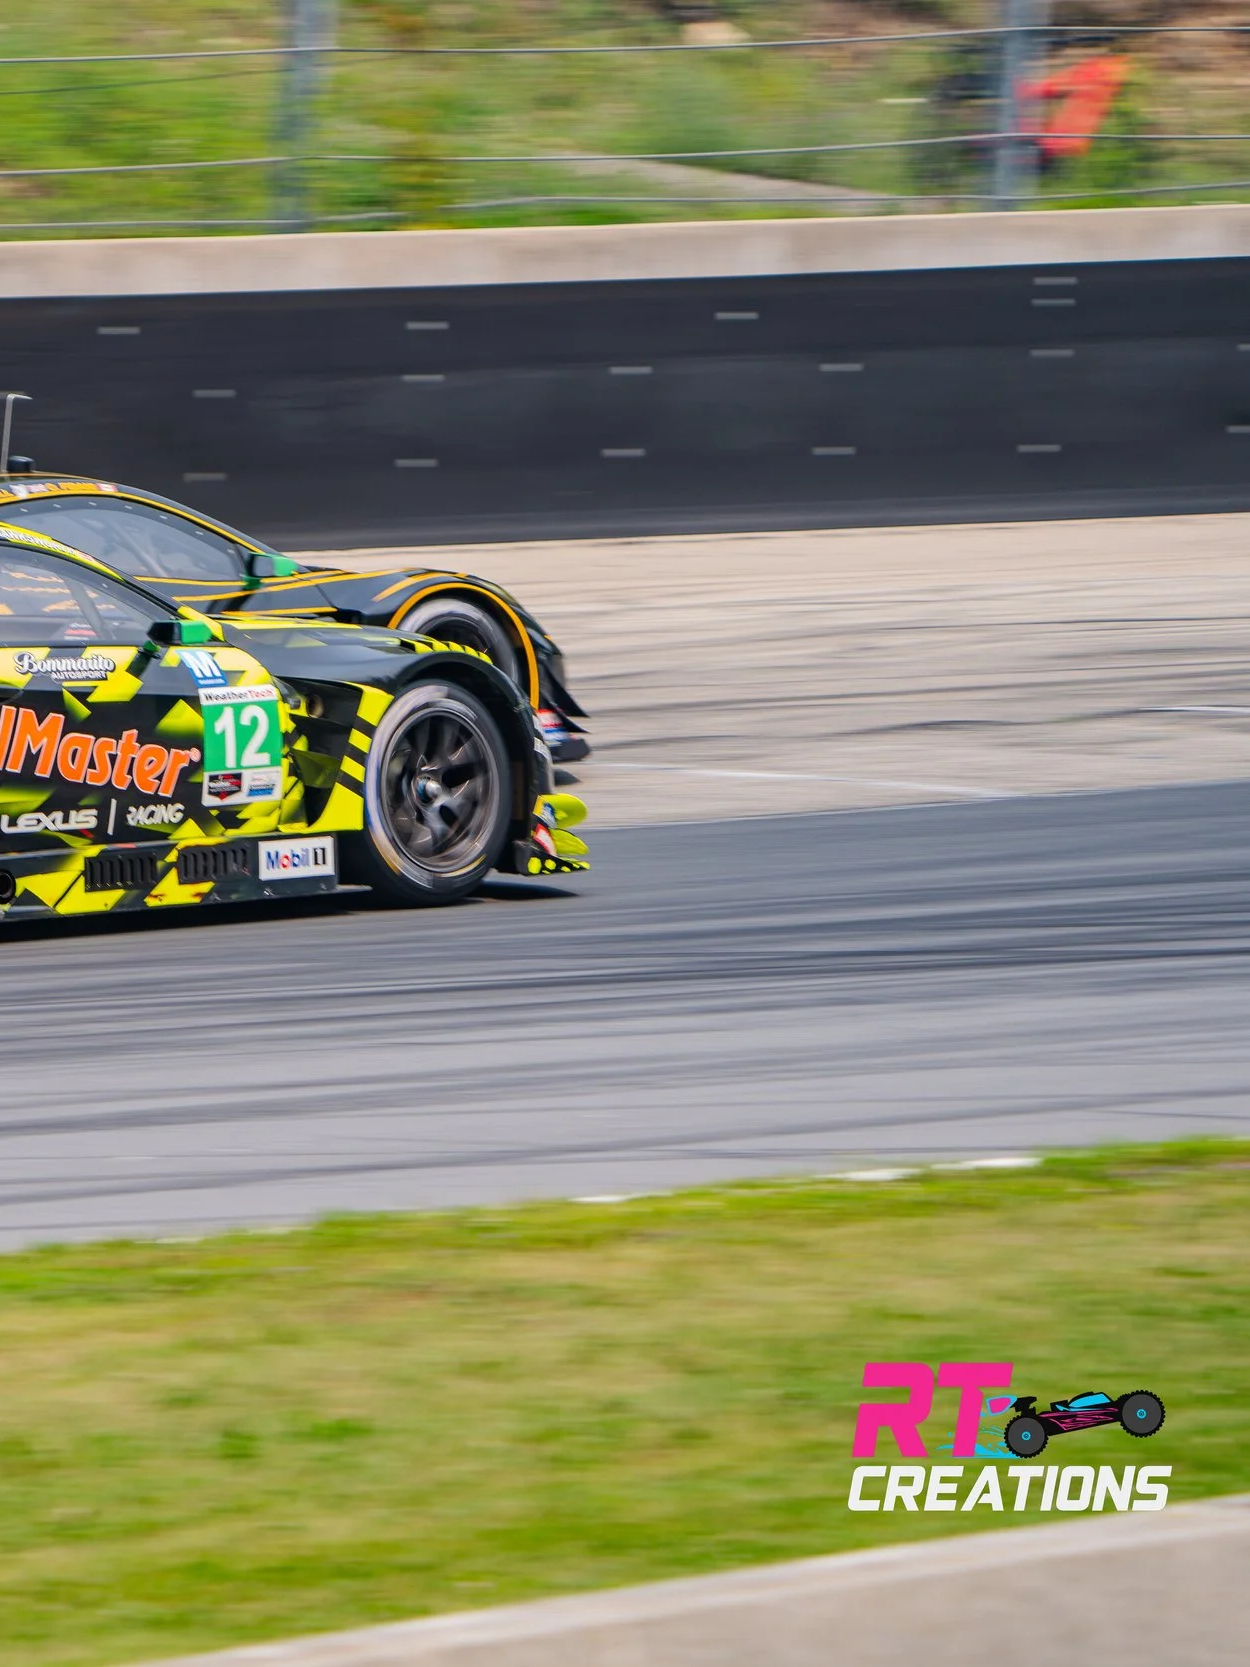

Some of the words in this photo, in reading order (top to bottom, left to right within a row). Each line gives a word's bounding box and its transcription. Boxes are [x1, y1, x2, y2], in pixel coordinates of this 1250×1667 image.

[13, 651, 116, 675] Bommarito
[51, 670, 107, 680] AUTOSPORT
[203, 689, 274, 702] WeatherTech
[214, 705, 270, 769] 12
[0, 808, 99, 834] LEXUS
[126, 802, 185, 827] RACING
[266, 848, 310, 871] Mobil
